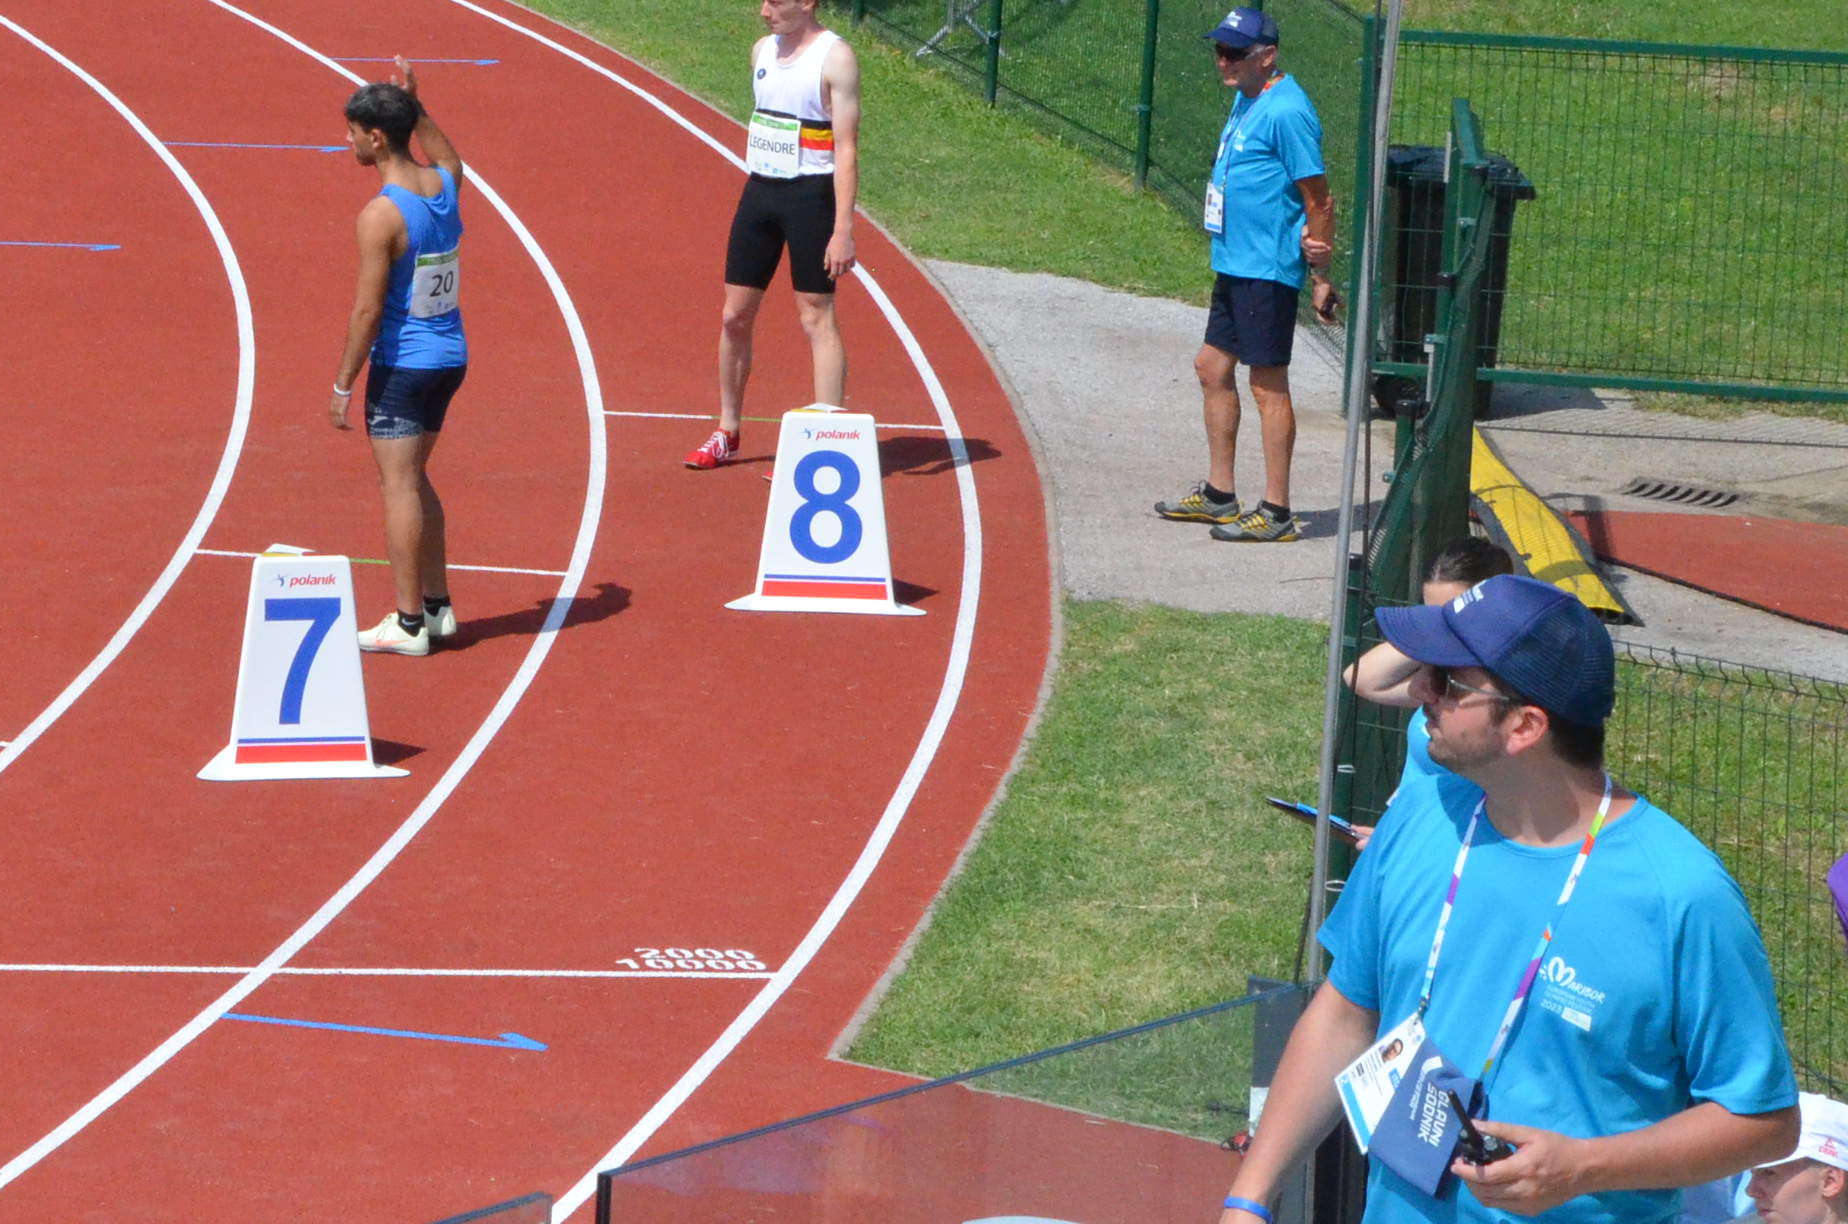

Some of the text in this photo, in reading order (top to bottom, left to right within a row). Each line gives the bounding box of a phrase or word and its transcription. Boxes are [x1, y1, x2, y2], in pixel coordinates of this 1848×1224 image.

[749, 134, 796, 156] LEGENDRE
[430, 270, 454, 297] 20
[815, 429, 861, 441] polanik
[789, 449, 863, 565] 8
[289, 574, 337, 588] polanik
[264, 597, 341, 725] 7
[615, 958, 767, 971] 10000
[634, 947, 756, 960] 2000
[1417, 1081, 1434, 1143] SODNIK
[1429, 1089, 1449, 1147] GLAVNI
